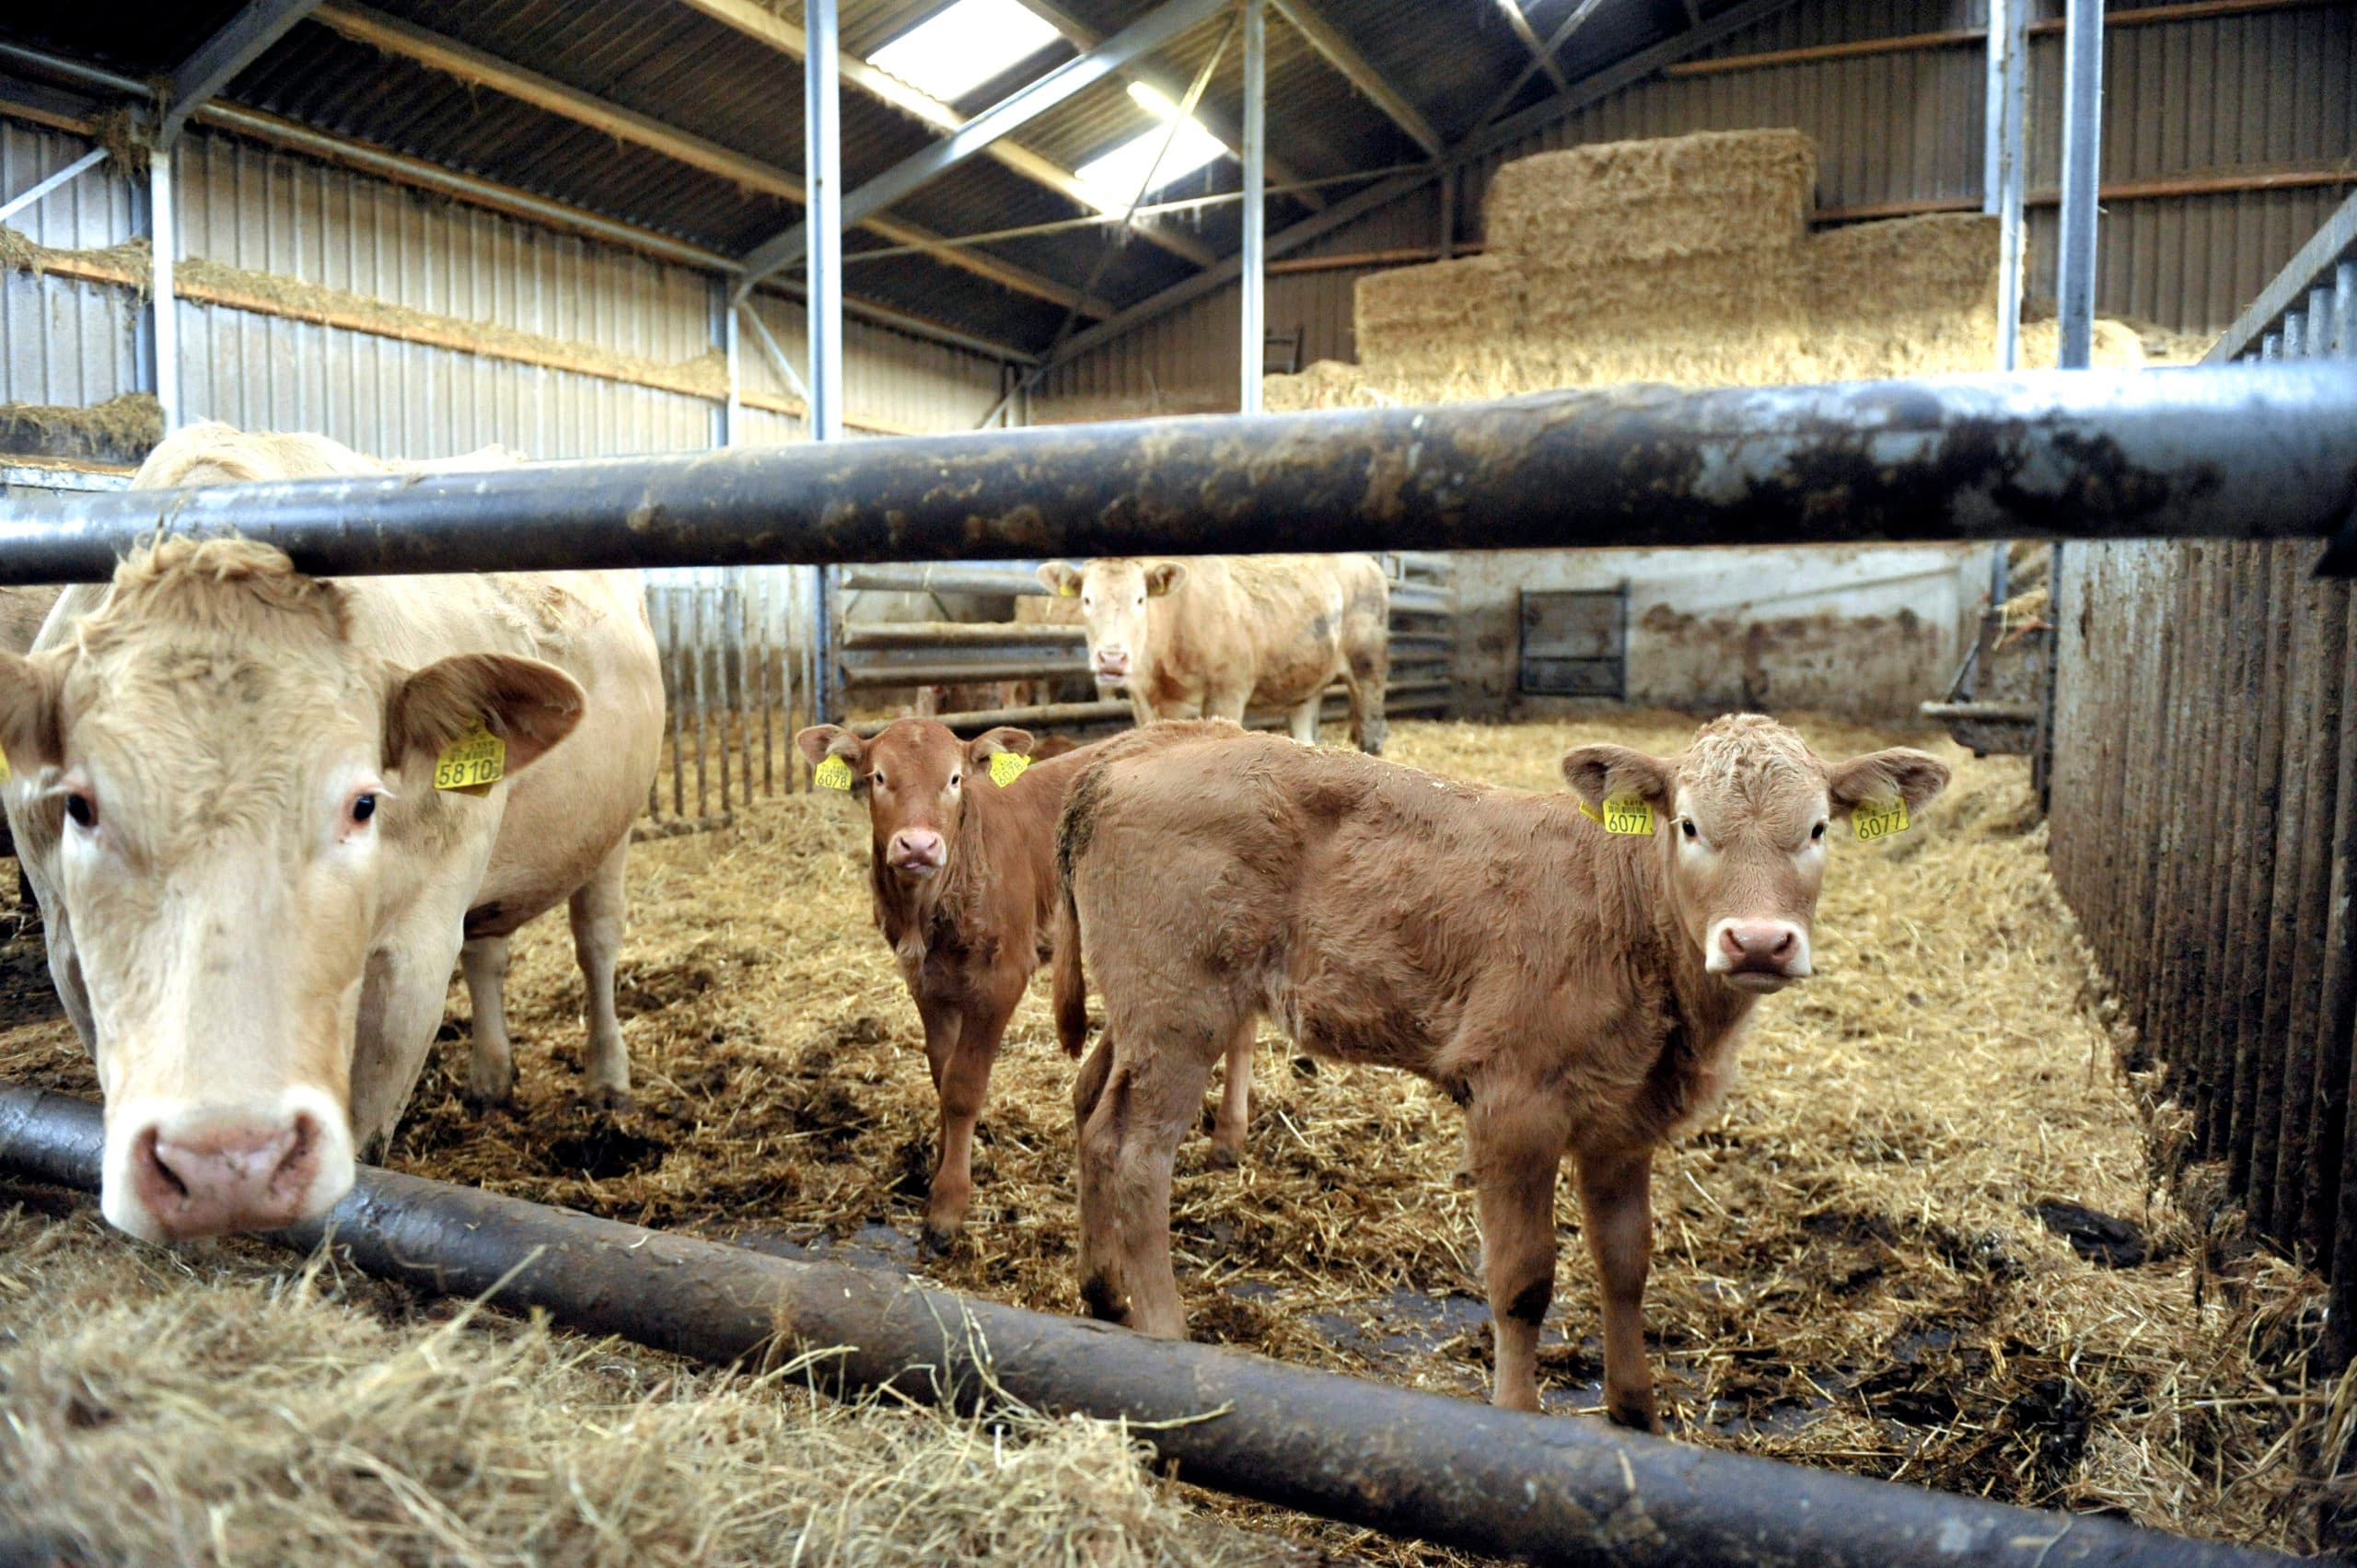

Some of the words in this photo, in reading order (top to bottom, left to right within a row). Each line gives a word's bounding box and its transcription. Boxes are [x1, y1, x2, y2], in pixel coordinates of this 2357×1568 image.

[438, 759, 493, 785] 5810
[818, 773, 847, 788] 6078
[999, 763, 1023, 785] 6078
[1609, 814, 1647, 833] 6077
[1860, 810, 1901, 840] 6077
